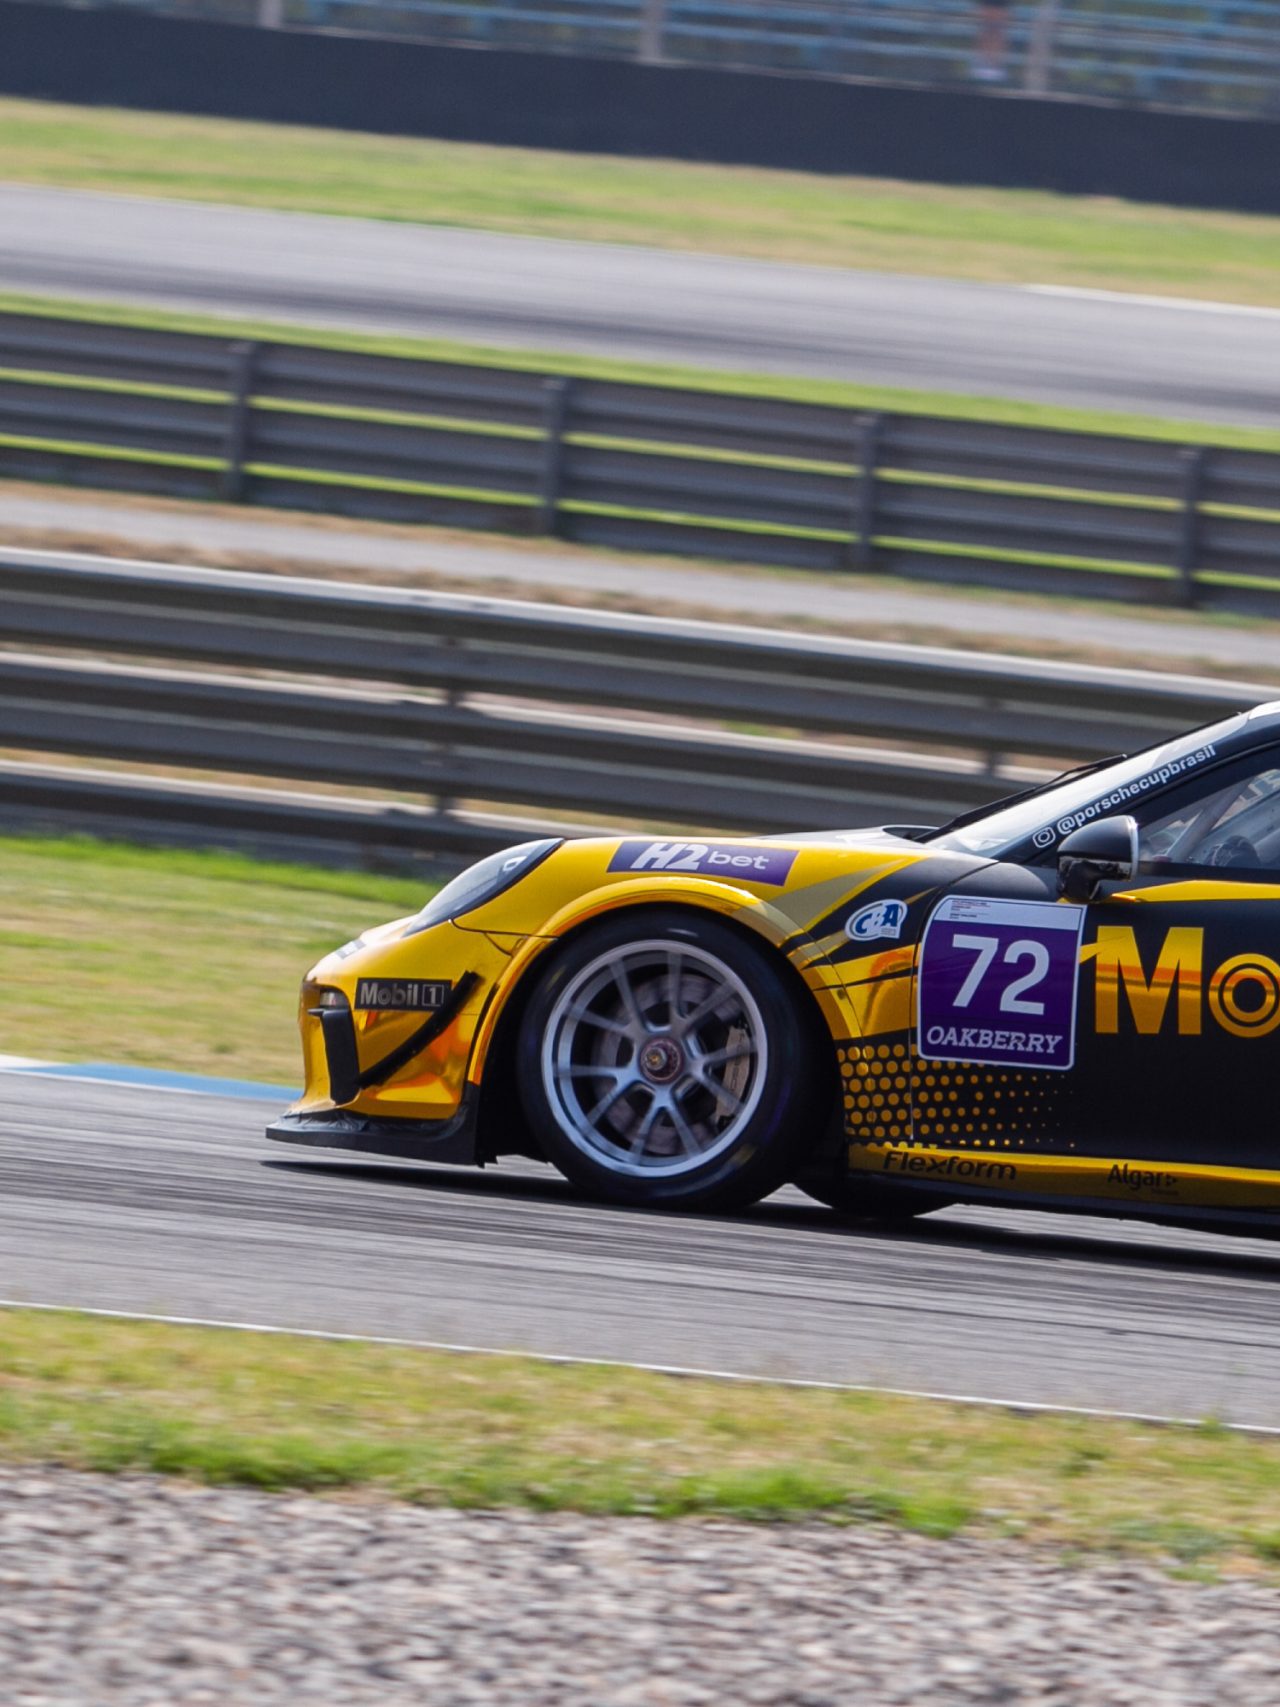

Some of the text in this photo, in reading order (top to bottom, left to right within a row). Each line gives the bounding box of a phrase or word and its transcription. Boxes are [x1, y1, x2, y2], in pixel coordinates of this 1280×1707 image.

[1057, 744, 1217, 835] @porschecupbrasil
[952, 933, 1050, 1016] 72
[360, 982, 418, 1006] Mobil
[926, 1025, 1063, 1054] OAKBERRY
[882, 1150, 1017, 1181] Flexform
[1107, 1163, 1164, 1190] Algar
